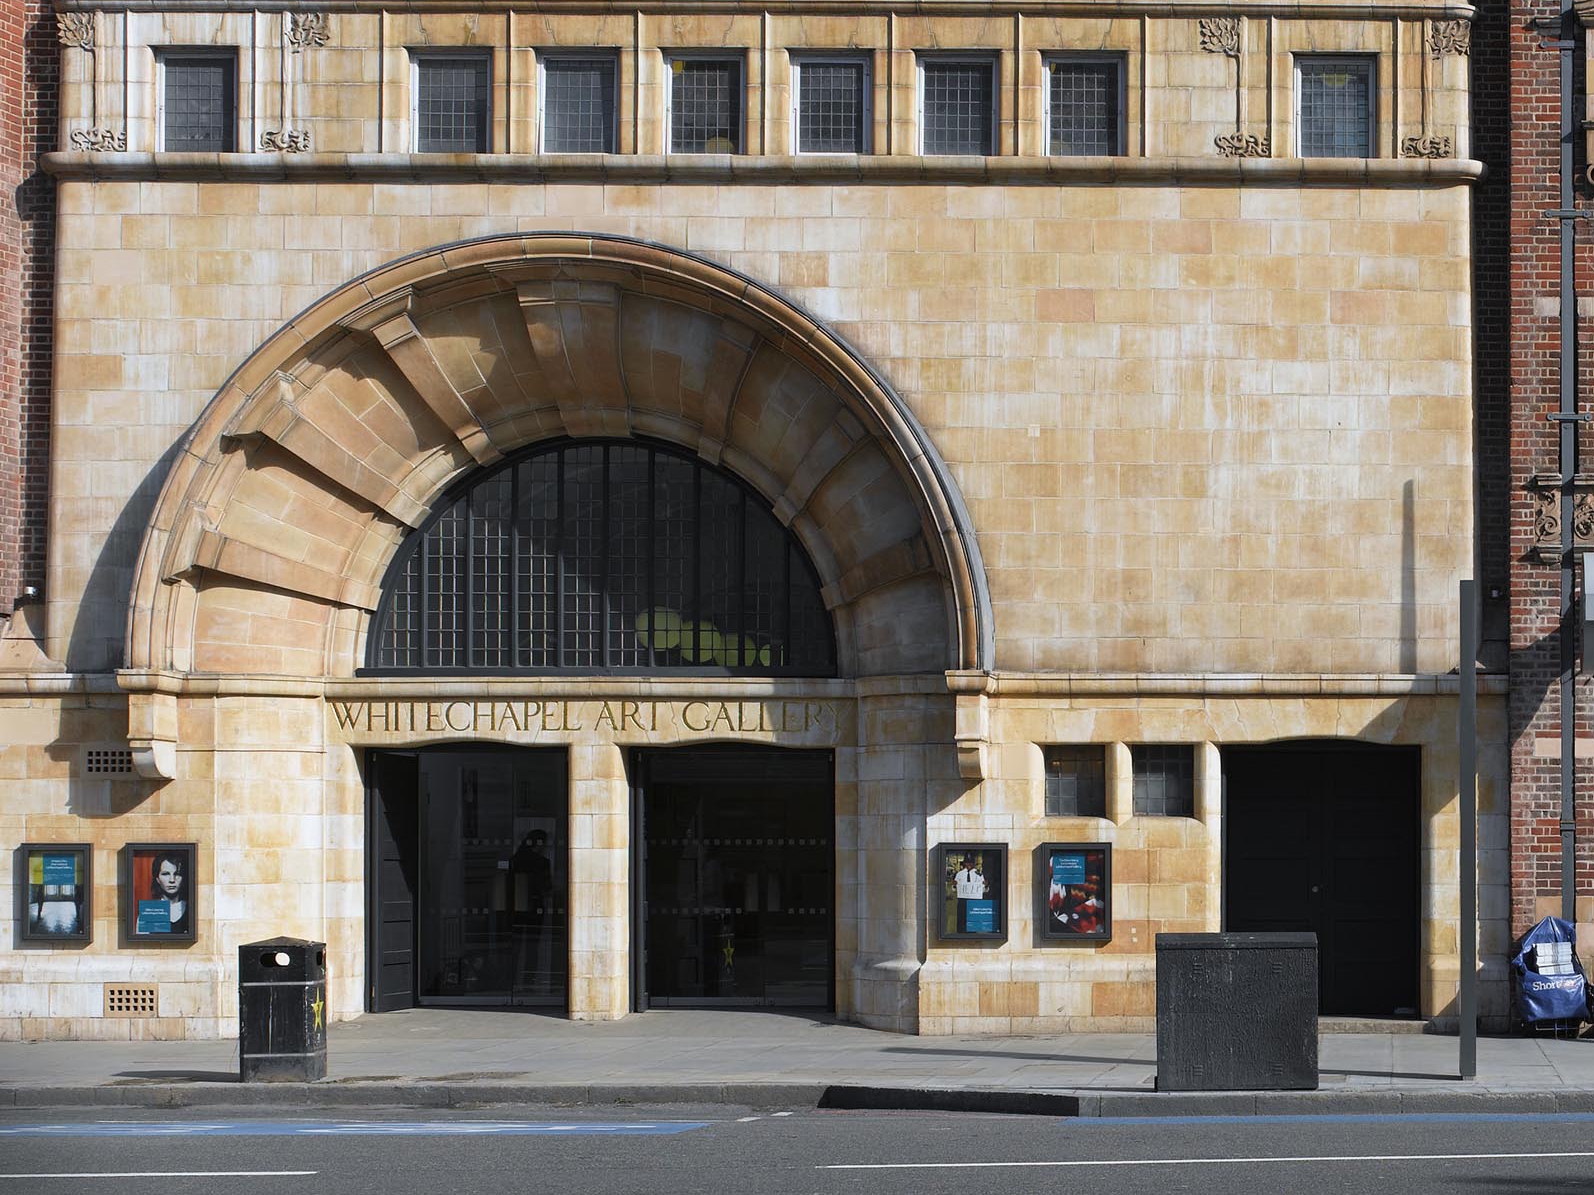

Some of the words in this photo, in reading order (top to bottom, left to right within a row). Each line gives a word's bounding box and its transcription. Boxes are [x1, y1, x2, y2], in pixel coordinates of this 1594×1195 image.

[330, 700, 582, 733] WHITECHAPEL
[594, 700, 667, 732] ART
[682, 700, 843, 733] GALLERY
